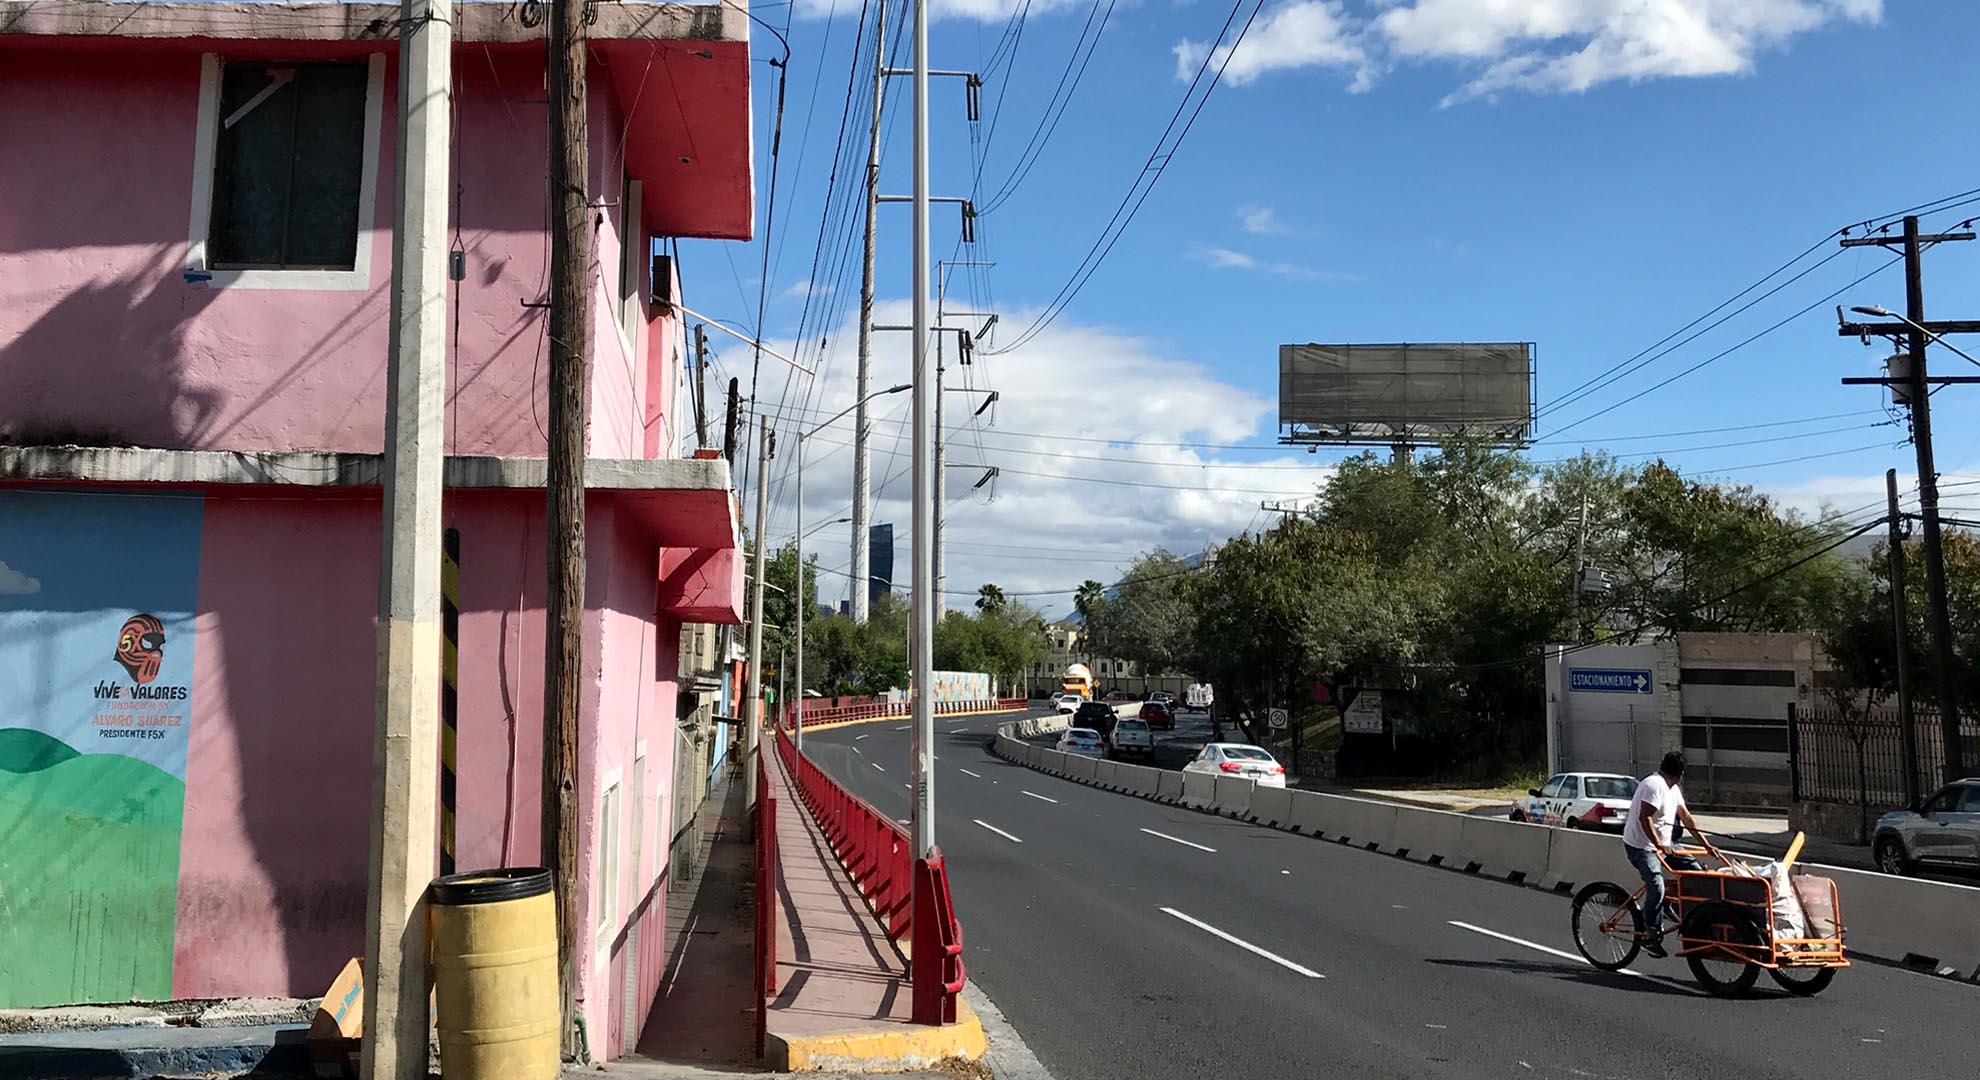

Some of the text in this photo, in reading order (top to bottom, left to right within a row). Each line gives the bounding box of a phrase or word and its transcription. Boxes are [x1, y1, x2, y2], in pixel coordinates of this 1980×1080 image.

[1573, 674, 1632, 687] ESTACIONAMIENTO
[94, 680, 121, 699] VIVE
[130, 683, 187, 700] VALORES
[99, 729, 146, 739] PRESIDENTE
